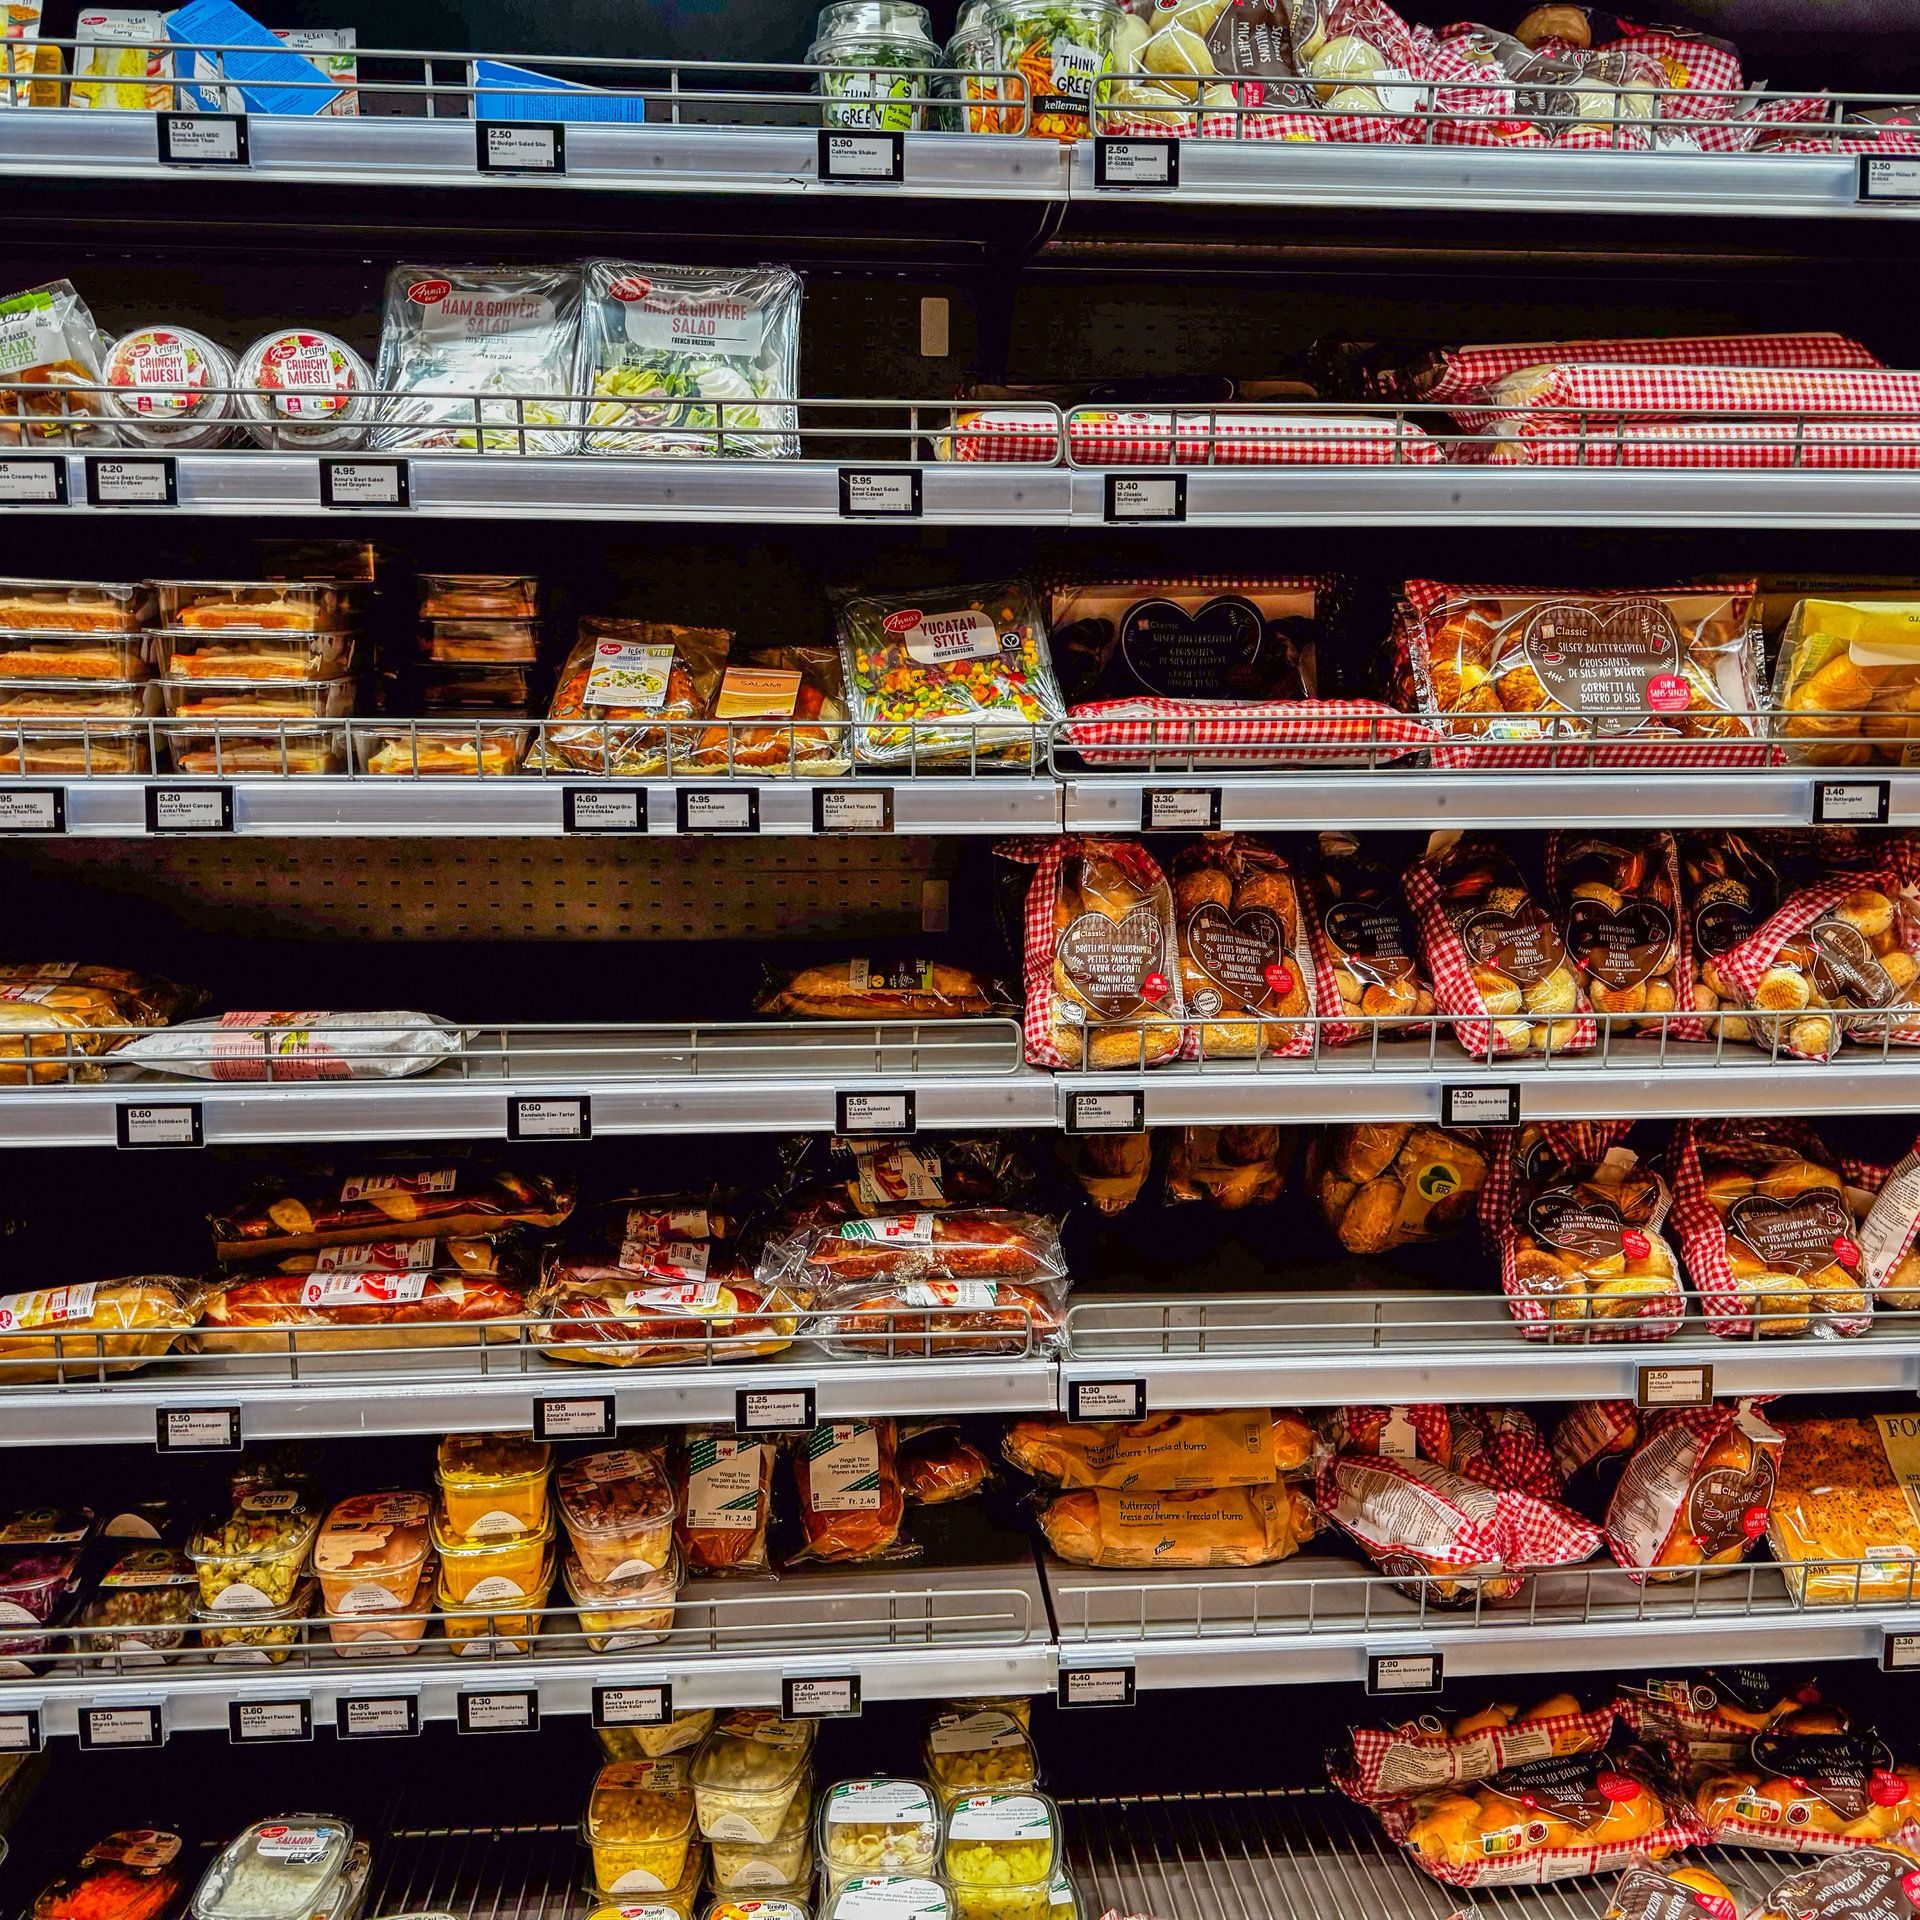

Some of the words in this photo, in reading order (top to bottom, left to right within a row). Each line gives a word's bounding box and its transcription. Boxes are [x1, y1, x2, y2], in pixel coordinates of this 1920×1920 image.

[1060, 54, 1096, 73] THINK
[1056, 76, 1091, 95] GREE
[172, 122, 193, 130] 3.50
[490, 130, 512, 138] 2.50
[832, 139, 852, 147] 3.90
[441, 298, 472, 314] HAM
[475, 300, 484, 316] &
[485, 298, 542, 318] GRUYÈRE
[678, 304, 688, 321] &
[689, 303, 748, 326] GRUYÈRE
[467, 319, 511, 334] SALAD
[672, 324, 716, 341] SALAD
[154, 344, 182, 357] Crispy!
[300, 345, 328, 357] Crispy!
[139, 357, 182, 370] CRUNCHY
[286, 359, 328, 372] CRUNCHY
[140, 370, 184, 383] MUESLI
[288, 371, 330, 385] MUESLI
[919, 616, 977, 636] YUCATAN
[1554, 625, 1587, 637] Classic
[933, 631, 970, 648] STYLE
[952, 646, 975, 656] DRESSING
[1557, 642, 1581, 652] SILSER
[1578, 656, 1629, 667] CROISSANTS
[1567, 667, 1578, 677] DE
[1580, 668, 1592, 677] SILS
[1595, 667, 1607, 677] AU
[1609, 666, 1645, 677] BEURRE
[1581, 682, 1622, 692] CORNETTI
[1624, 682, 1635, 692] AL
[1579, 692, 1607, 702] BURRO
[1609, 692, 1618, 702] DI
[1620, 692, 1639, 703] SILS
[1080, 930, 1105, 939] Classic
[1097, 975, 1117, 984] PANINI
[1088, 984, 1110, 993] FARINA
[1116, 1448, 1142, 1459] beurre
[1146, 1446, 1172, 1456] Treccia
[1174, 1443, 1182, 1451] al
[1184, 1442, 1207, 1452] burro
[252, 1495, 289, 1505] PESTO
[1120, 1500, 1161, 1512] Butterzopf
[1120, 1513, 1141, 1521] Tresse
[1155, 1512, 1180, 1521] beurre
[1185, 1512, 1211, 1521] Treccia
[1212, 1512, 1220, 1520] al
[1221, 1512, 1243, 1522] burro
[1807, 1566, 1830, 1574] SANS
[1828, 1776, 1860, 1787] BURRO
[1555, 1791, 1582, 1802] BURRO
[1762, 1809, 1769, 1818] D
[275, 1836, 314, 1845] SALMON
[1508, 1838, 1514, 1846] D
[1815, 1869, 1866, 1902] BUTTERZOPF
[644, 1908, 665, 1917] Ready!
[767, 1904, 788, 1912] Ready!
